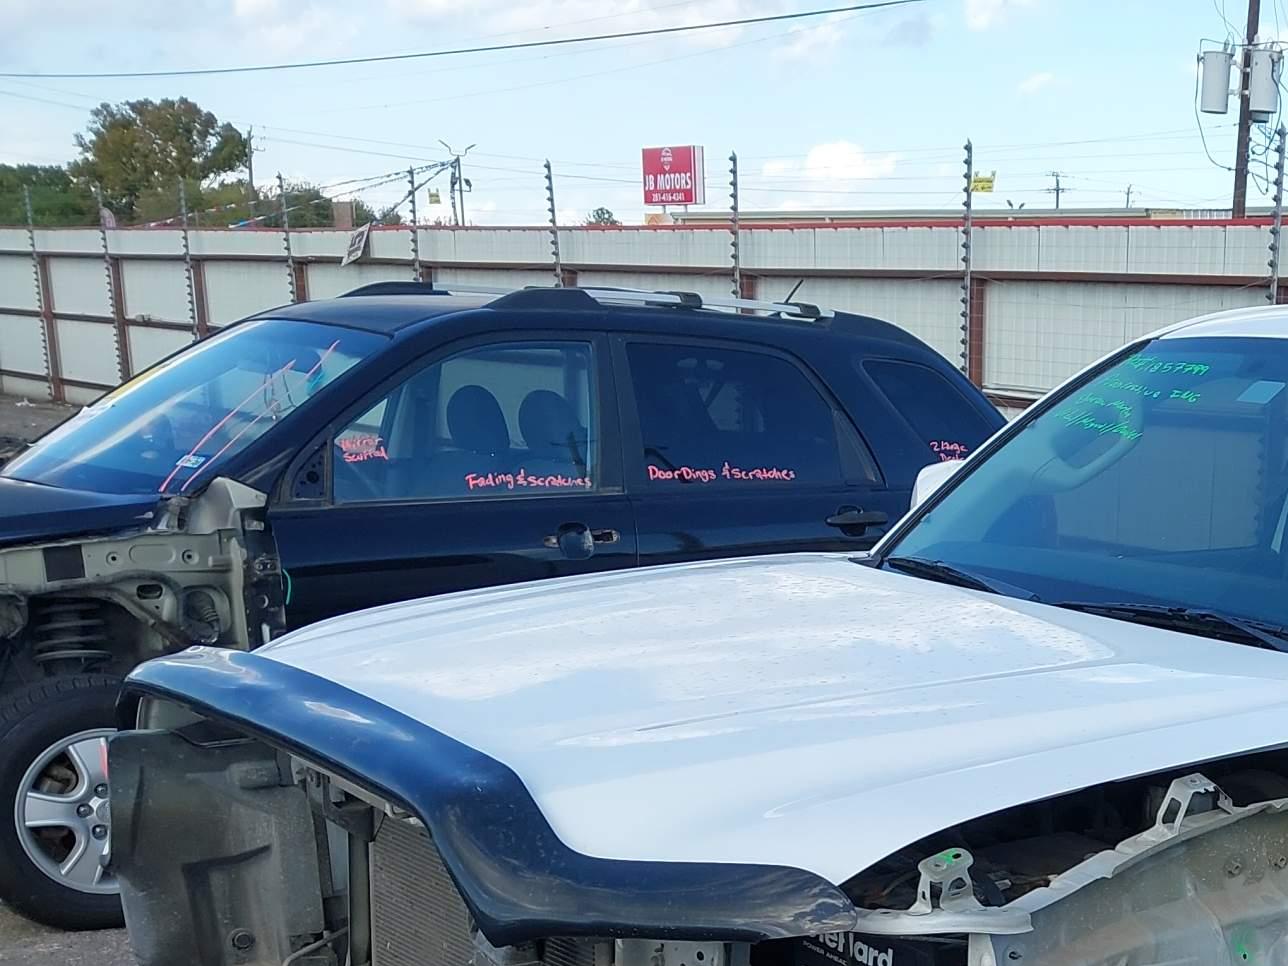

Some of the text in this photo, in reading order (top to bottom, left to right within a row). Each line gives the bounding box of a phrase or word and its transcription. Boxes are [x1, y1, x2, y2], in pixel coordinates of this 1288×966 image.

[645, 172, 692, 191] JB MOTORS
[465, 472, 514, 490] Fading
